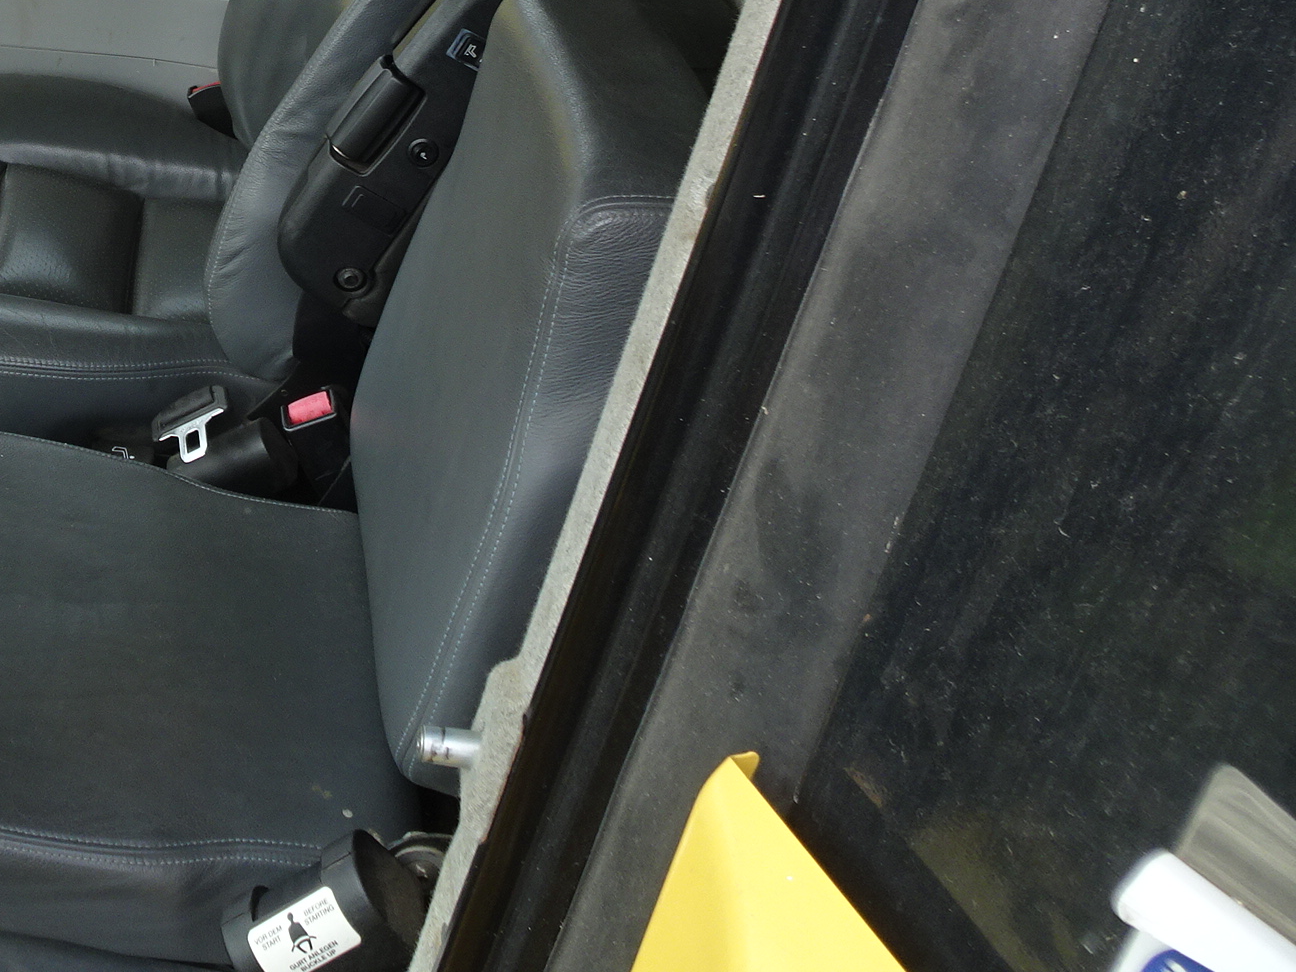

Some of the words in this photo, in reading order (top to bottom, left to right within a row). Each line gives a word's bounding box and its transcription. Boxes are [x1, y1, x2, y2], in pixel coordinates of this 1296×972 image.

[303, 898, 329, 916] BEFORE
[304, 904, 335, 926] STARTING
[268, 925, 283, 938] DEM
[262, 935, 282, 951] START
[289, 956, 309, 971] GURT
[308, 940, 338, 961] ANLEGEN
[300, 955, 326, 972] BUCKLE
[326, 949, 337, 959] UP
